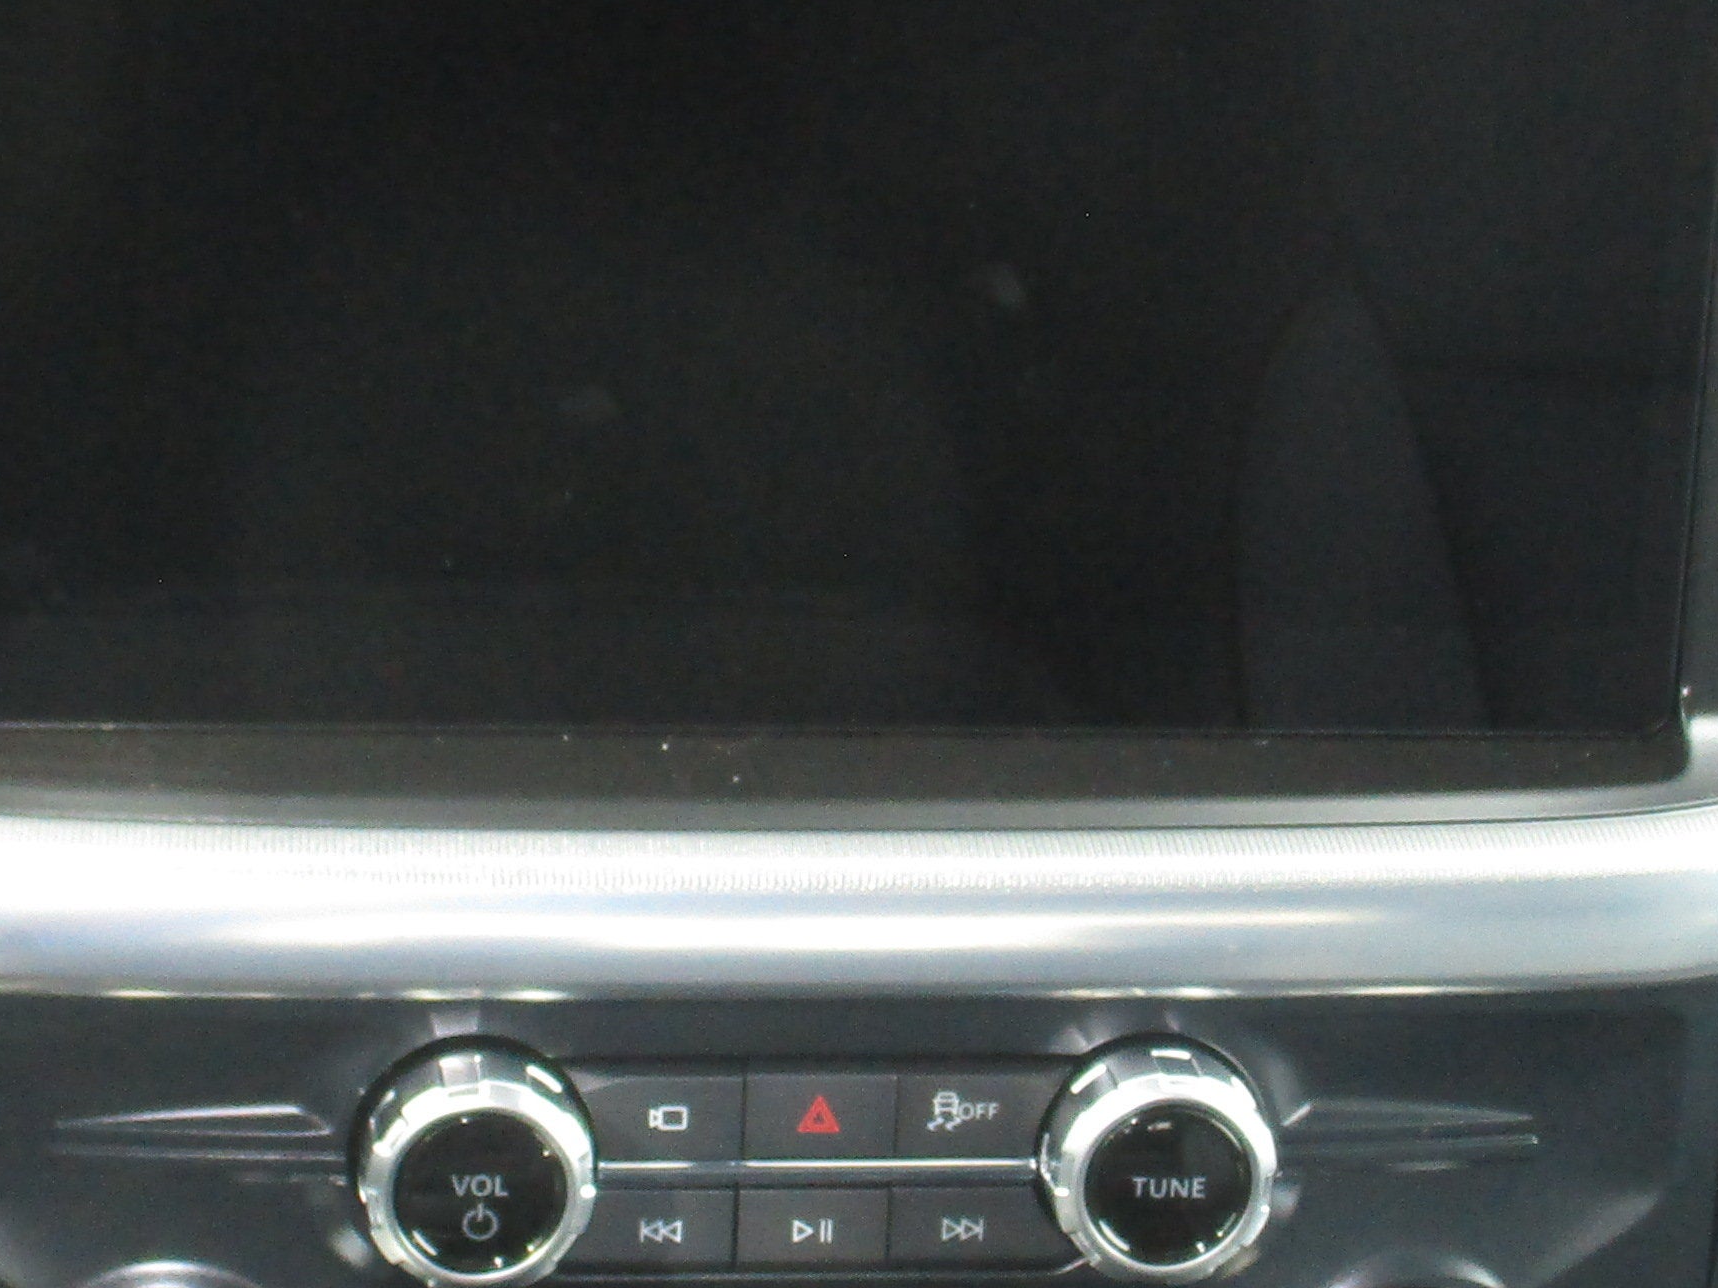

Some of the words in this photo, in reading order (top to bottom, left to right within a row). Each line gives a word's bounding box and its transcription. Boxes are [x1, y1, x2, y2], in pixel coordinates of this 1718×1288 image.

[959, 1101, 999, 1122] OFF
[450, 1174, 509, 1198] VOL
[1131, 1175, 1208, 1200] TUNE
